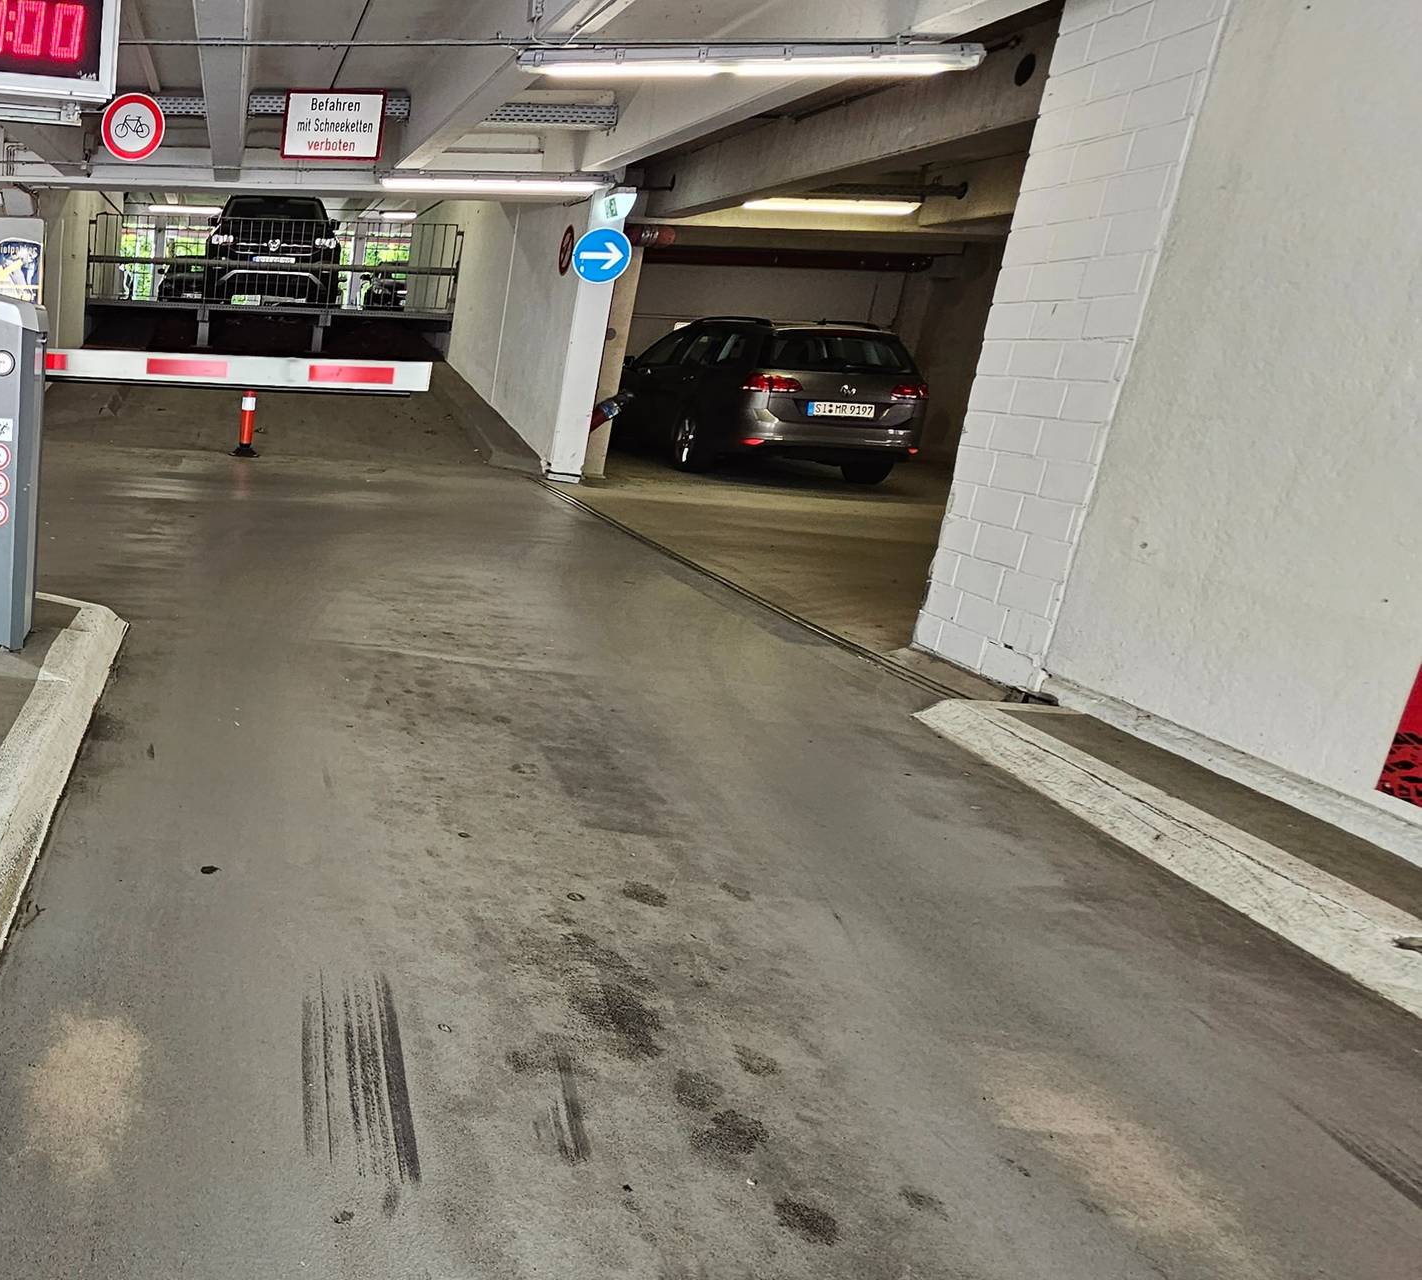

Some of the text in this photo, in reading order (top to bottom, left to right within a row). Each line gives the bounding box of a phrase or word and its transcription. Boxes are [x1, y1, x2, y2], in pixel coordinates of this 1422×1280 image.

[311, 98, 361, 112] Befahren
[296, 118, 373, 133] mit Schneeketten
[308, 138, 356, 152] verboten
